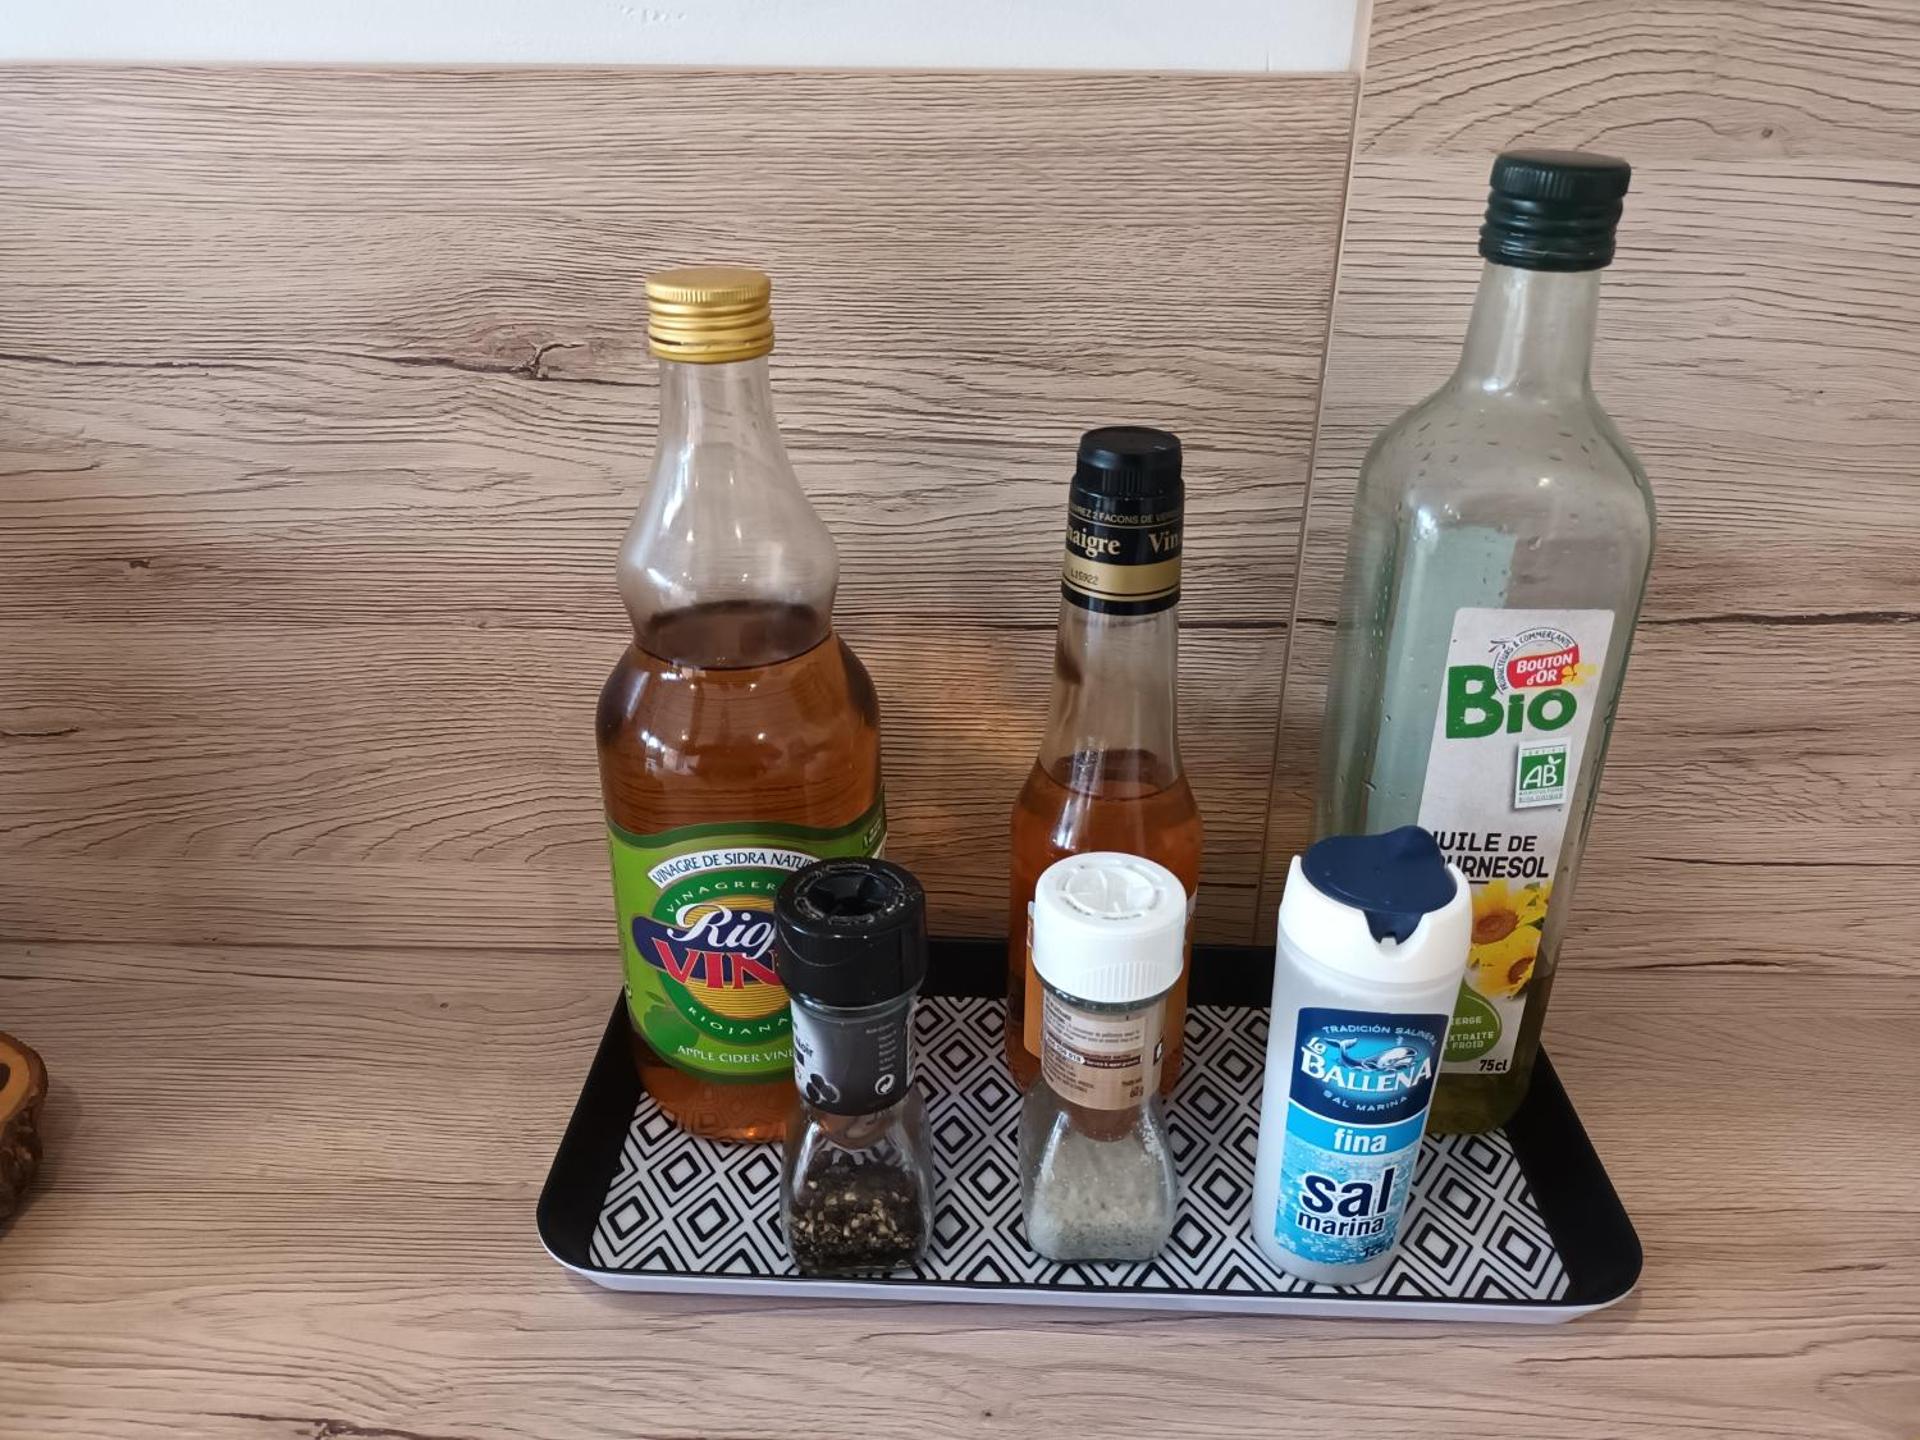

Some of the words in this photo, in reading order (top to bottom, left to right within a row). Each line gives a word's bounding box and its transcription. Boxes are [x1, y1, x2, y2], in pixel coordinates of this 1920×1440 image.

[1516, 653, 1573, 674] BOUTON
[1446, 665, 1577, 739] Bio
[1522, 764, 1558, 789] AB
[1508, 835, 1538, 852] DE
[652, 856, 702, 884] VINAGRE
[702, 854, 721, 868] DE
[725, 851, 767, 865] SIDRA
[1442, 855, 1549, 878] RNESOL
[687, 1006, 789, 1034] RIOJANA
[1322, 1024, 1391, 1035] TRADICIÓN
[1453, 1015, 1483, 1025] ERGE
[677, 1045, 715, 1062] APPLE
[718, 1052, 760, 1064] CIDER
[1479, 1059, 1508, 1072] 75cl
[1301, 1046, 1432, 1092] BALLENA
[1323, 1090, 1350, 1108] SAL
[1356, 1096, 1408, 1112] MARINA
[1334, 1128, 1388, 1153] fina
[1302, 1167, 1396, 1218] sal
[1297, 1212, 1385, 1236] marina
